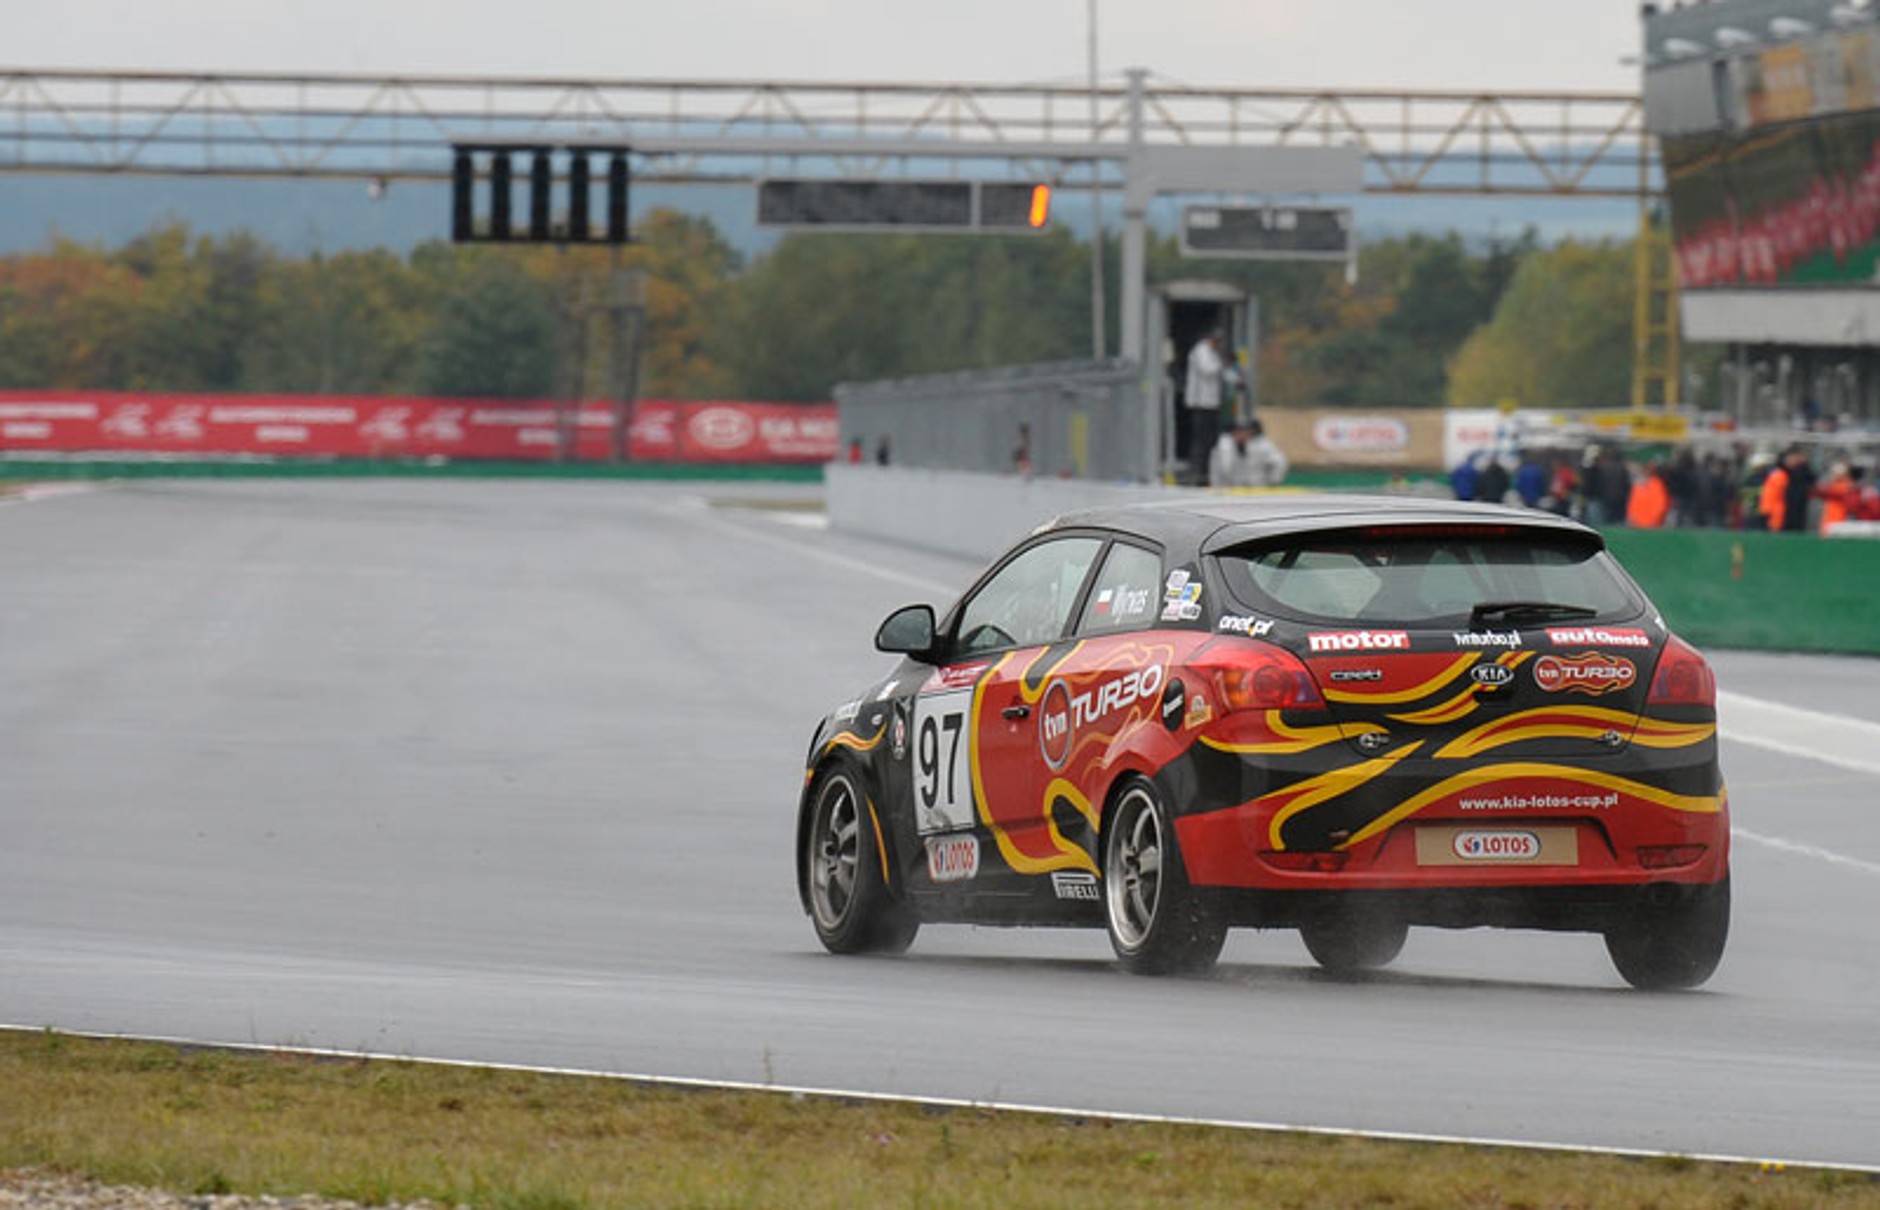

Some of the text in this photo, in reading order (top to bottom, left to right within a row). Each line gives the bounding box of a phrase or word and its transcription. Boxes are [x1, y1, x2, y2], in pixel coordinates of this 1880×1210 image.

[1308, 631, 1408, 651] motor
[1477, 667, 1508, 680] KIA
[1538, 665, 1633, 679] tvn TURBO
[1044, 711, 1068, 741] tvn
[1070, 663, 1163, 729] TURBO
[919, 711, 964, 809] 97
[1459, 792, 1619, 811] www.kia-lotos-cup.pl
[1482, 836, 1531, 854] LOTOS
[945, 840, 974, 873] LOTOS
